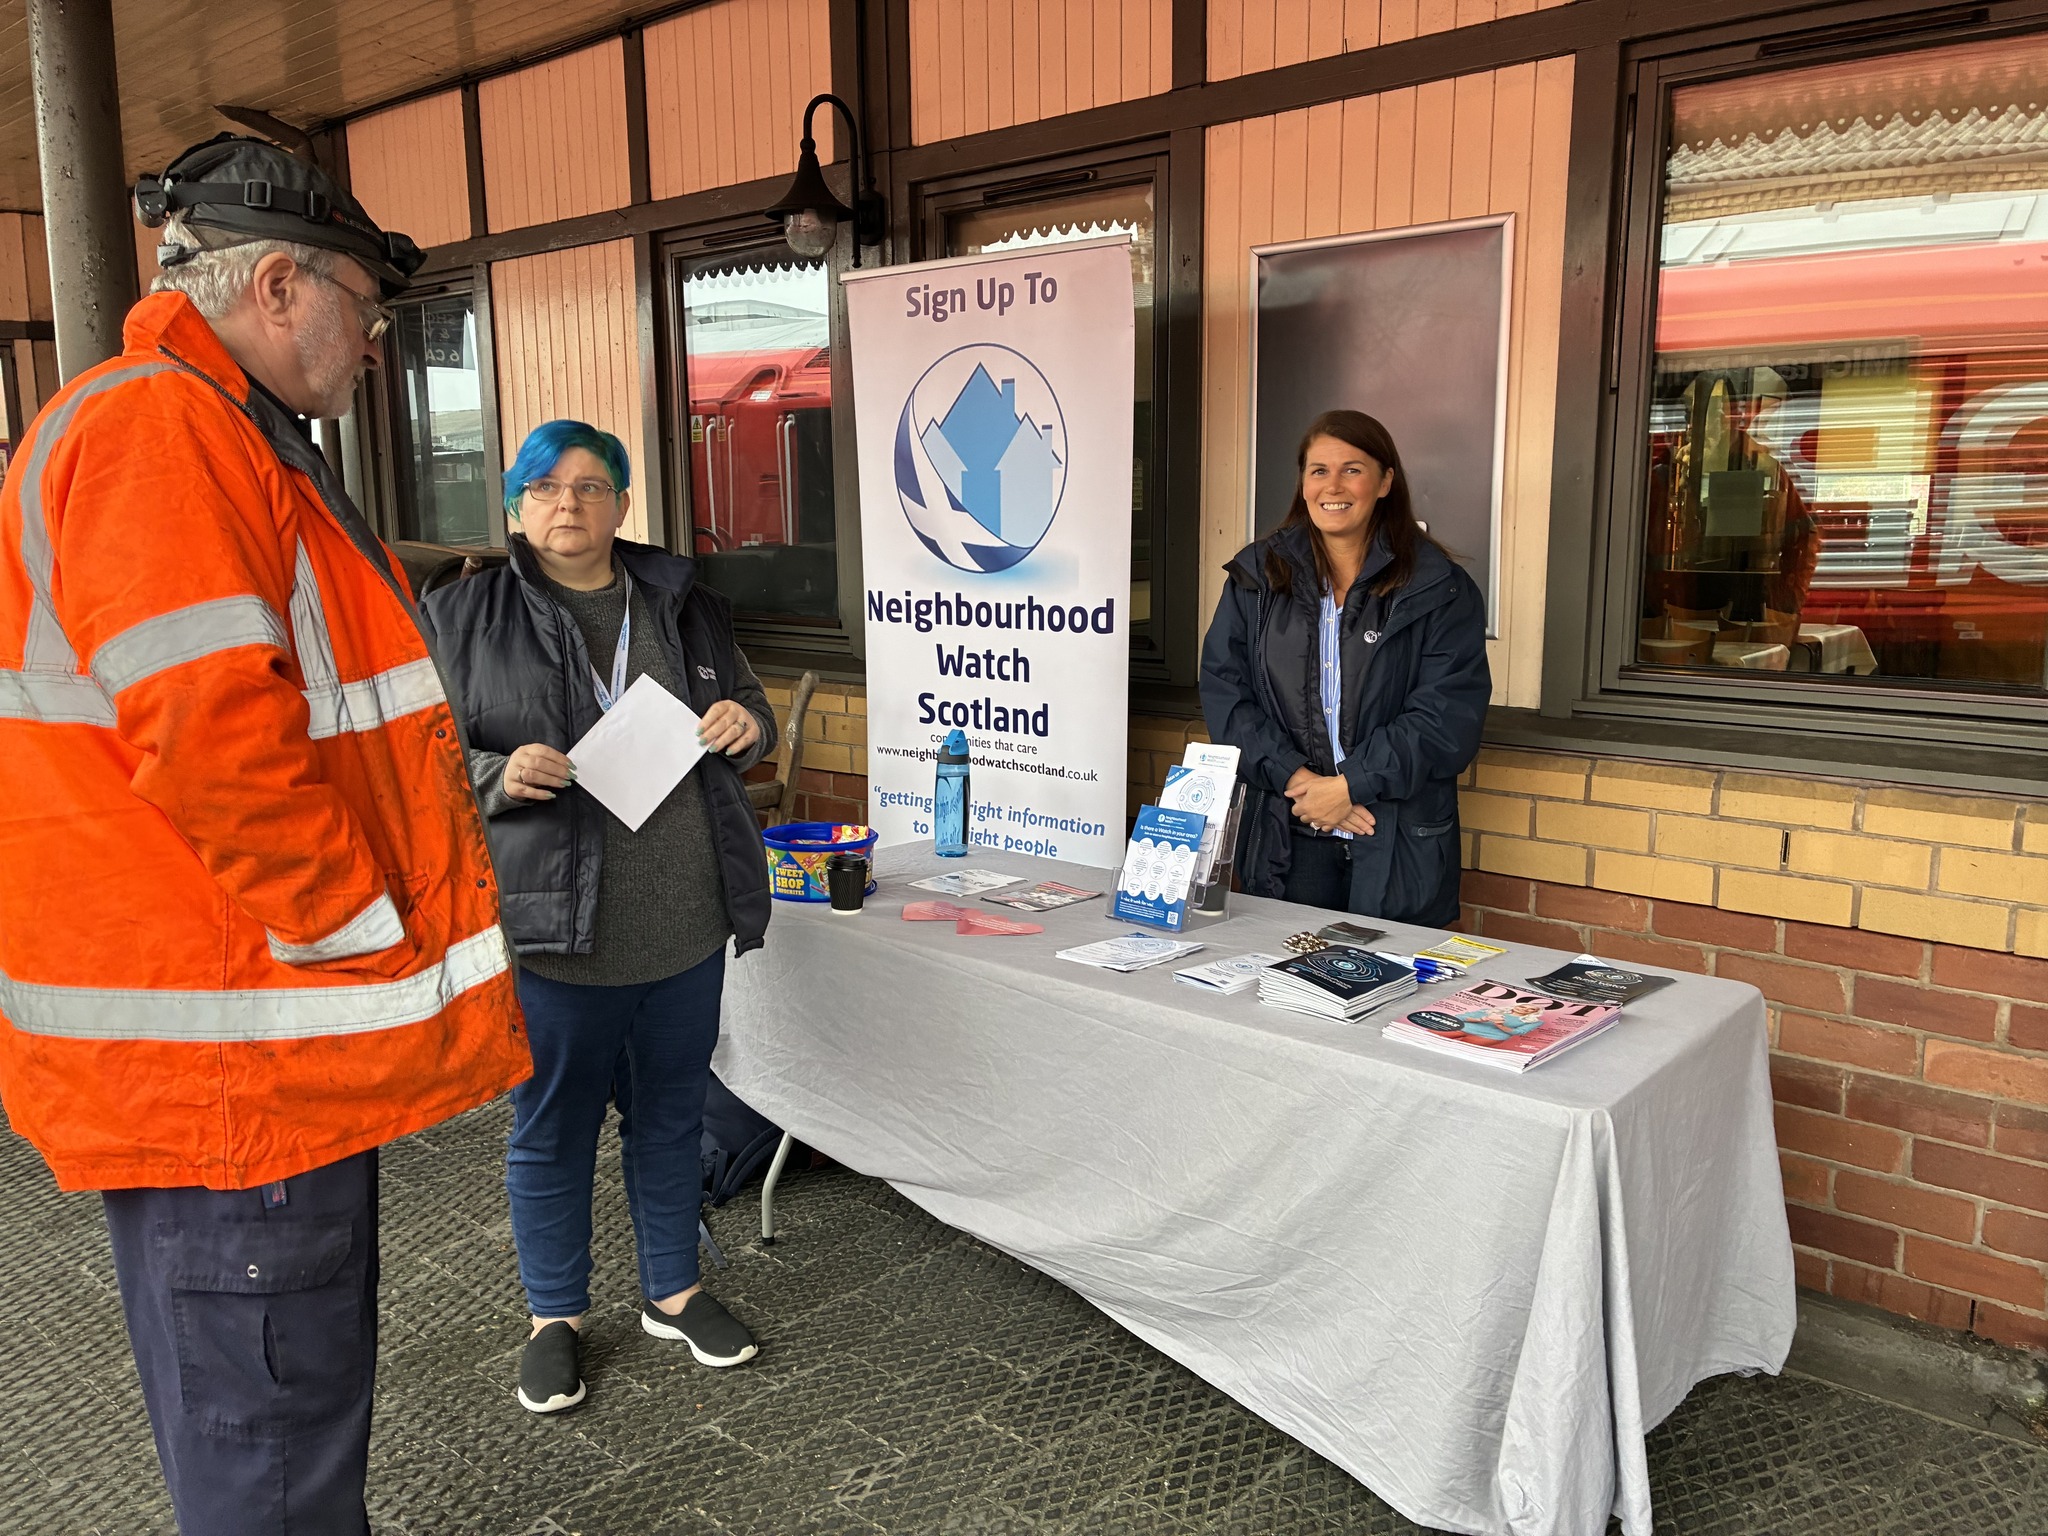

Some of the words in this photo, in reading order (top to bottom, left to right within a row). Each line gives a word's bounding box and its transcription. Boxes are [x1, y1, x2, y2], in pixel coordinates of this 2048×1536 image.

[906, 284, 966, 322] Sign
[976, 277, 1015, 316] Up
[1024, 271, 1058, 305] To
[868, 590, 1115, 635] Neighbourhood
[936, 644, 1030, 683] Watch
[918, 693, 1050, 737] Scotland
[994, 738, 1015, 752] that
[1016, 742, 1038, 755] care
[1008, 807, 1106, 836] information
[1159, 827, 1171, 835] Watch
[913, 820, 929, 834] to
[969, 827, 999, 847] ight
[1004, 834, 1058, 857] people
[776, 867, 804, 878] SWEET
[776, 876, 805, 890] SHOP
[1572, 975, 1597, 985] Rural
[1469, 982, 1612, 1017] DOT
